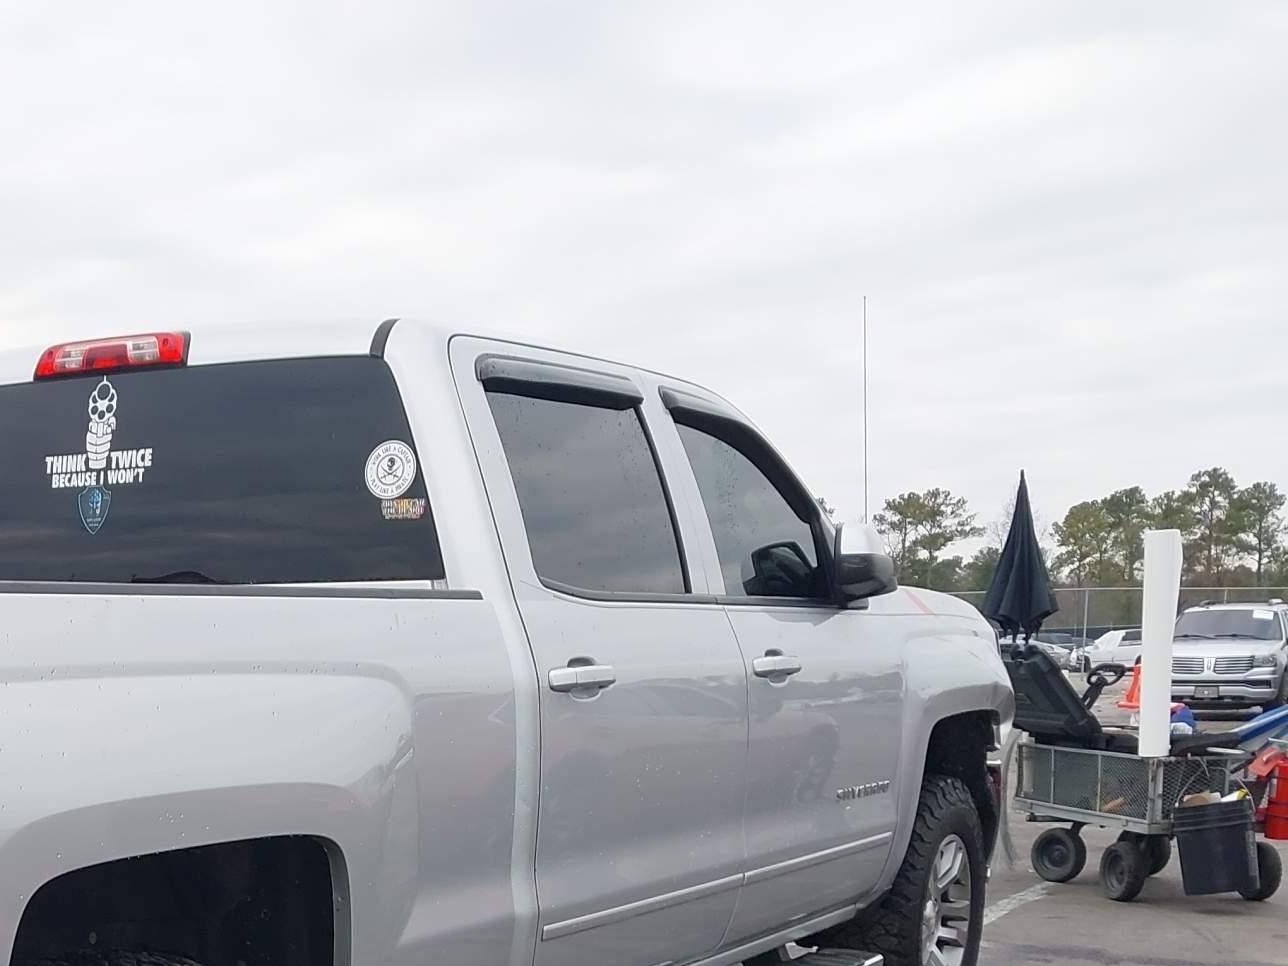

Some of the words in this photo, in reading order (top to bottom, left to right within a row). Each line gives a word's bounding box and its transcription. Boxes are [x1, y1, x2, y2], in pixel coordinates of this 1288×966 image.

[45, 454, 87, 474] THINK
[110, 448, 153, 468] TWICE
[51, 471, 97, 488] BECAUSE
[99, 471, 104, 485] I
[107, 468, 145, 484] WON'T
